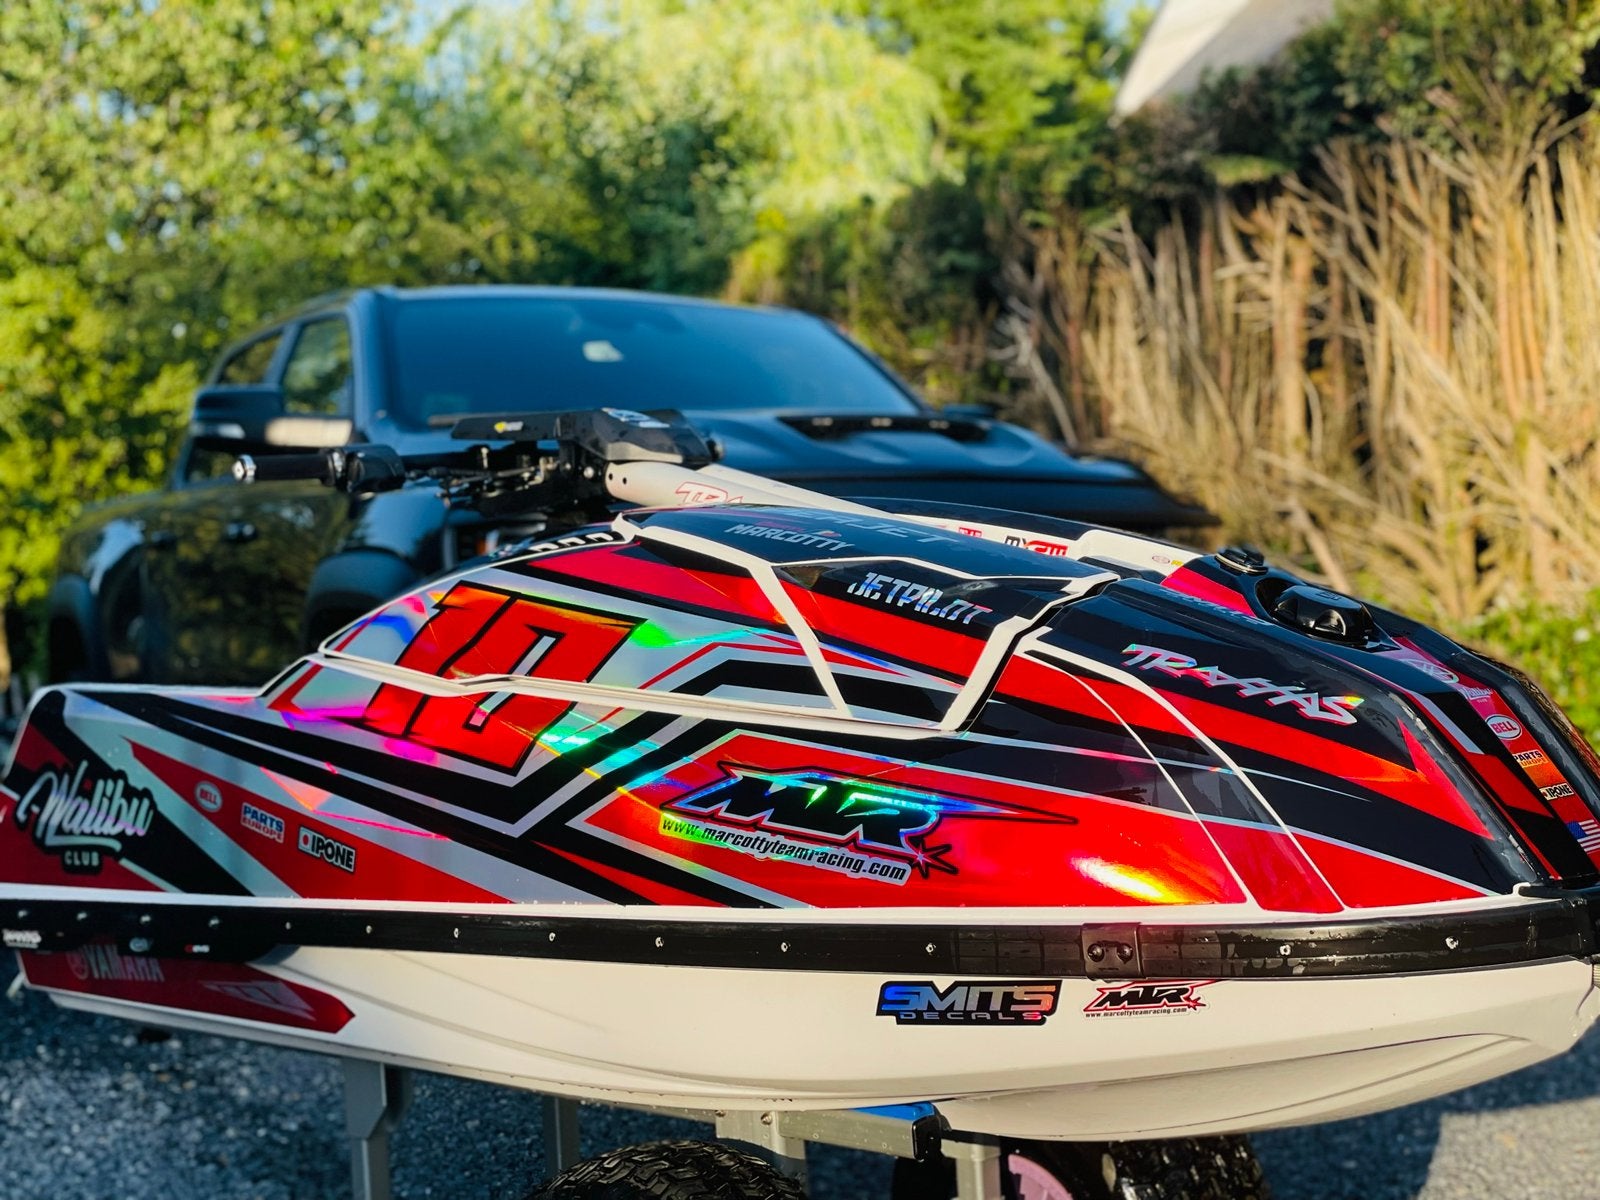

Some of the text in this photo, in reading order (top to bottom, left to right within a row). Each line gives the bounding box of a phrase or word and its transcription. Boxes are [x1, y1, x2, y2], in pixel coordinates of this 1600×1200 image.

[724, 524, 856, 551] MARCOTTY
[847, 572, 993, 624] JETPILOT
[325, 580, 648, 775] 10
[1121, 643, 1365, 726] TRAXXAS
[1491, 720, 1518, 734] BELL
[200, 788, 218, 805] BELL
[1547, 783, 1573, 798] IPONE
[243, 804, 284, 832] PARTS
[672, 765, 940, 854] MTR
[242, 816, 284, 842] EUROPE
[64, 851, 100, 868] CLUB
[312, 834, 354, 869] IPONE
[661, 818, 908, 881] www.marcottyteamracing.com
[84, 944, 165, 983] YAMAHA
[881, 985, 1057, 1011] SMITS
[1090, 983, 1194, 1009] MTR
[900, 1011, 1042, 1020] DECALS
[1085, 1007, 1187, 1018] www.marcottyteamracing.com
